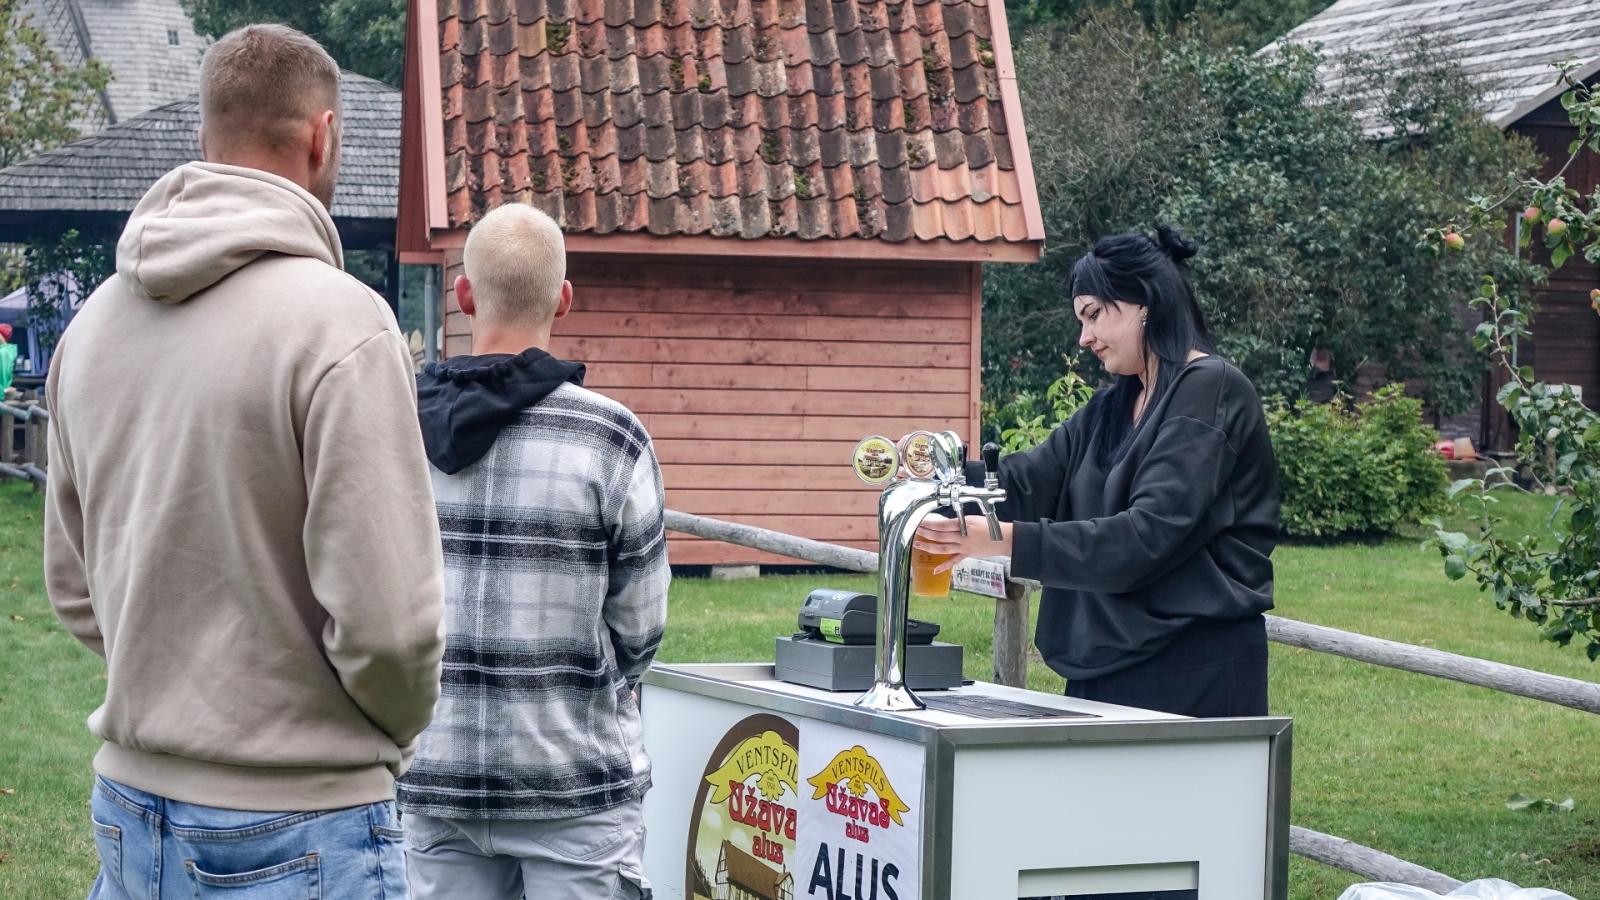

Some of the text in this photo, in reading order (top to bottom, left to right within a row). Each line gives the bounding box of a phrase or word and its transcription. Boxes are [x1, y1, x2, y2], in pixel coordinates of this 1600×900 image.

[831, 757, 885, 791] VENTSPILS
[846, 819, 869, 843] alus
[752, 832, 784, 865] alus
[808, 842, 900, 900] ALUS
